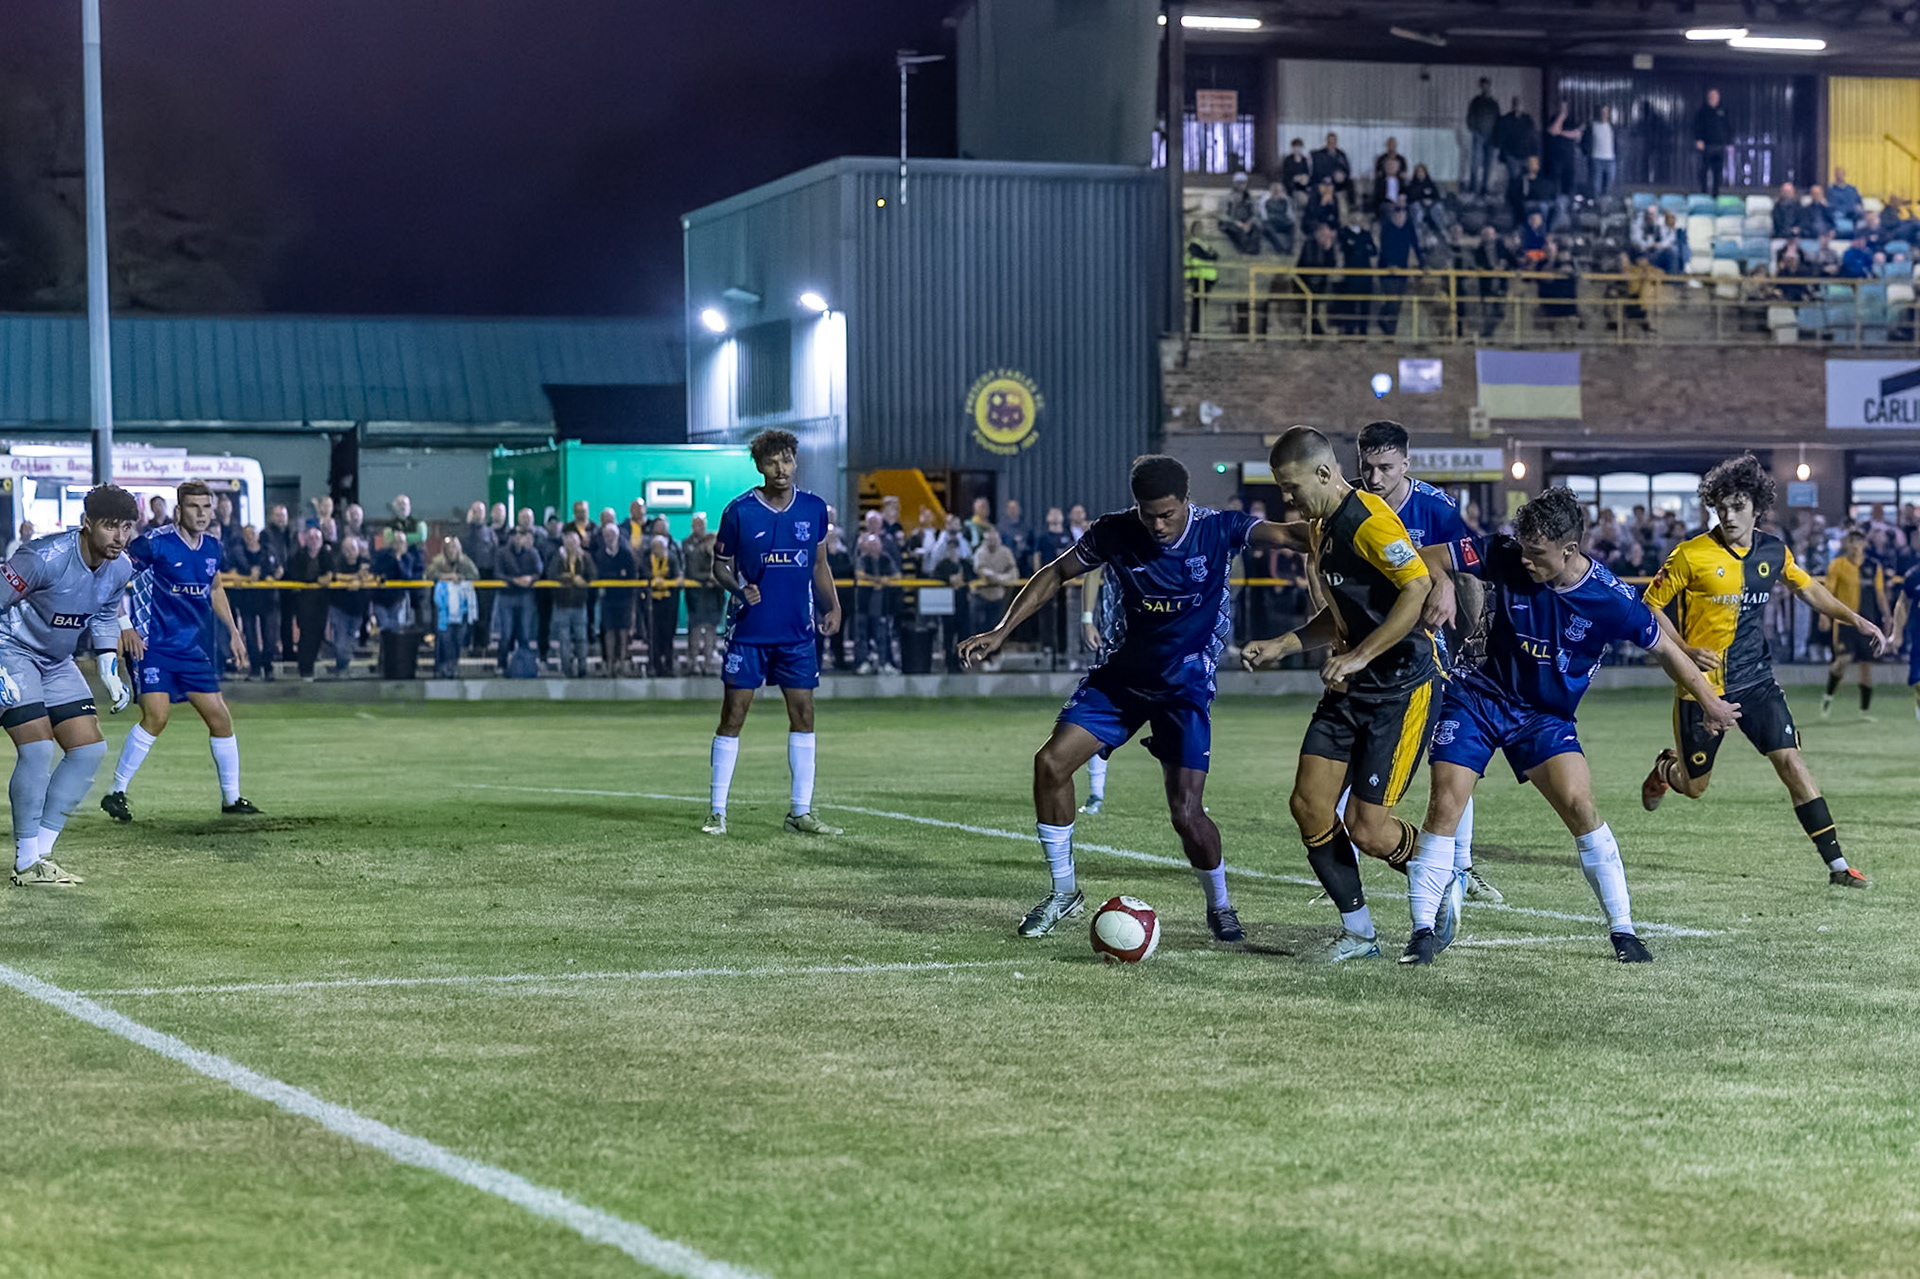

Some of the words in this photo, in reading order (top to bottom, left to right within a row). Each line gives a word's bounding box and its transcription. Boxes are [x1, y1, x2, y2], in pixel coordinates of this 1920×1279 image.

[1864, 398, 1920, 423] CARLI
[53, 615, 82, 627] BAL
[1520, 640, 1551, 659] ALL
